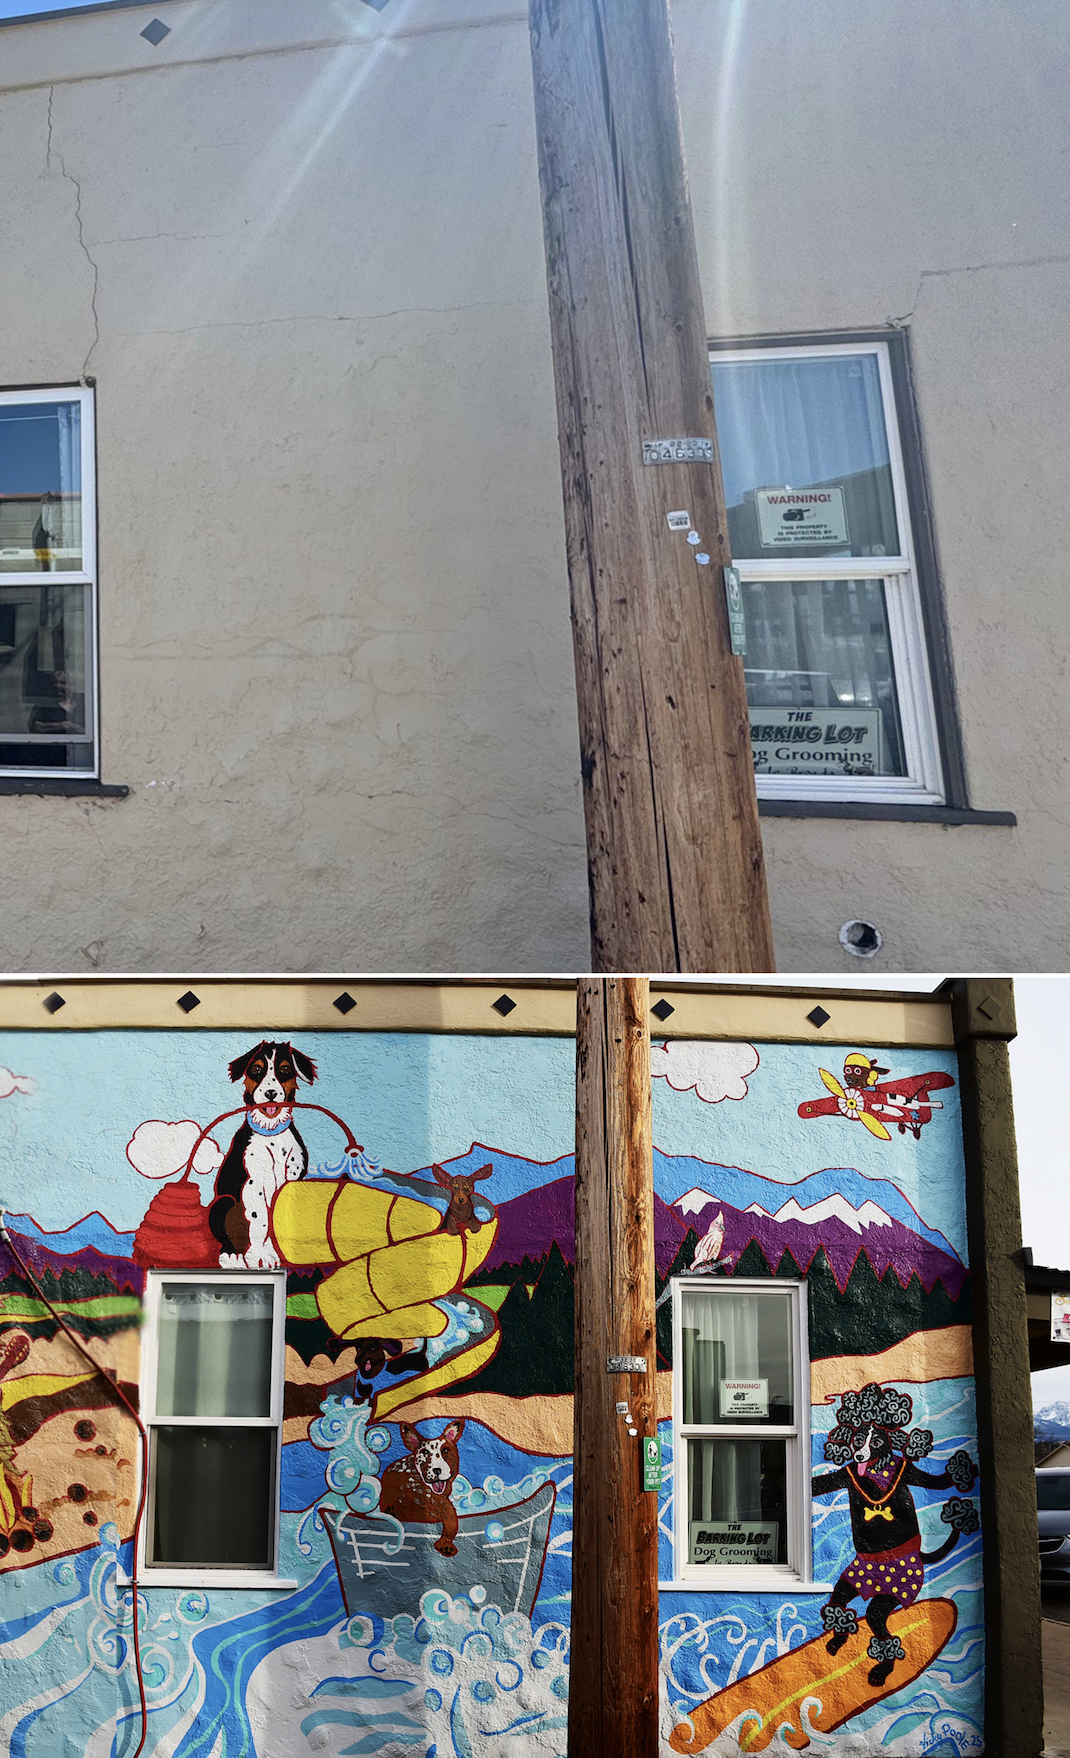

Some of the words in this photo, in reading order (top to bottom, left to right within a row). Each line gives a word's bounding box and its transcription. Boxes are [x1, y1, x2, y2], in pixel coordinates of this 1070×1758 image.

[767, 493, 832, 505] WARNING!
[787, 711, 813, 722] THE
[749, 724, 823, 743] ARKING
[824, 724, 868, 745] LOT
[751, 750, 769, 764] og
[775, 747, 873, 766] Grooming
[696, 1530, 746, 1545] BARKING
[746, 1532, 771, 1545] LOT
[694, 1547, 716, 1558] Dog
[719, 1547, 773, 1558] Grooming
[971, 1734, 983, 1748] 25
